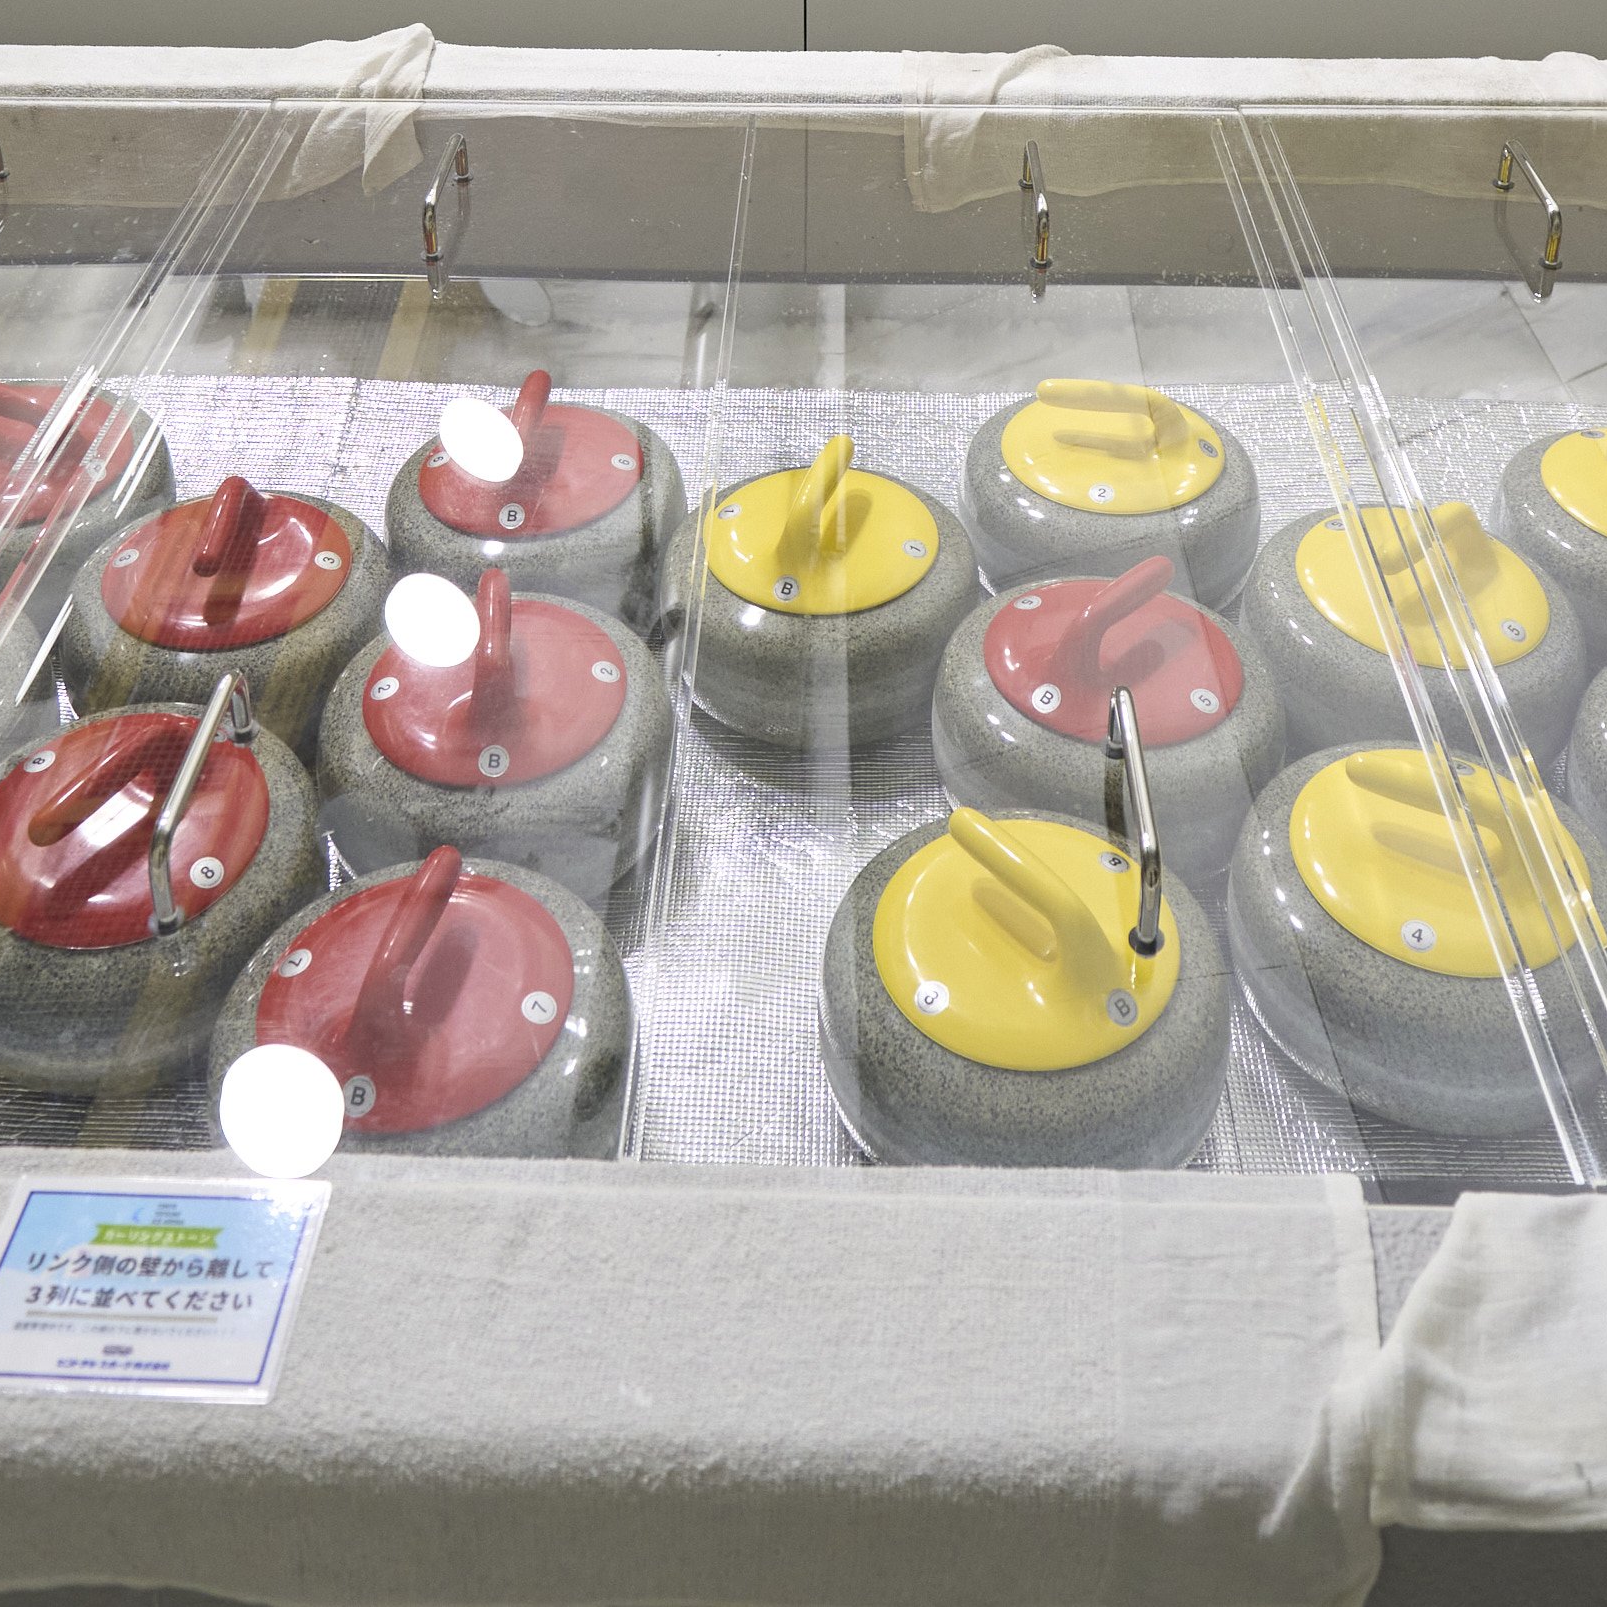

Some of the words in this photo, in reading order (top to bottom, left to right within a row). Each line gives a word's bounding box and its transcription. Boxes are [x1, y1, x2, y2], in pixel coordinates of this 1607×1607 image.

[1040, 690, 1054, 705] B
[531, 1000, 548, 1014] 7
[1114, 997, 1130, 1017] B
[350, 1086, 366, 1107] B
[28, 1253, 274, 1279] リンク側の壁から離して
